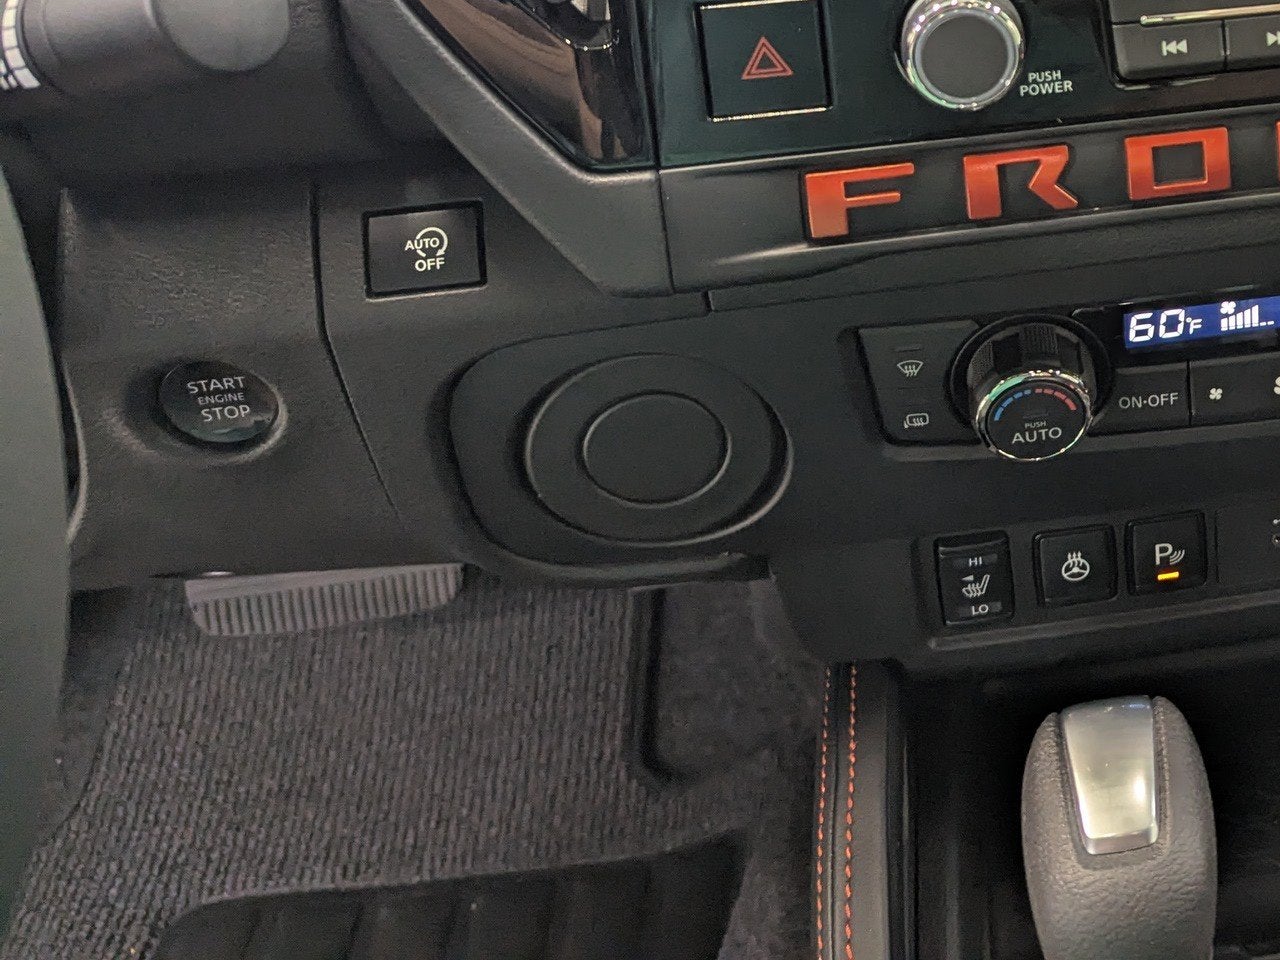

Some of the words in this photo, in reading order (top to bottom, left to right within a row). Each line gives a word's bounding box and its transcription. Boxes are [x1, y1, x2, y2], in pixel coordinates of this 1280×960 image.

[1027, 69, 1062, 83] PUSH
[1019, 80, 1074, 97] POWER
[404, 237, 440, 251] AUTO
[414, 257, 446, 272] OFF
[187, 376, 246, 394] START
[198, 392, 245, 405] ENGINE
[201, 404, 250, 422] STOP
[1024, 420, 1047, 429] PUSH
[1011, 427, 1063, 445] AUTO
[968, 555, 983, 567] HI
[971, 604, 989, 616] LO
